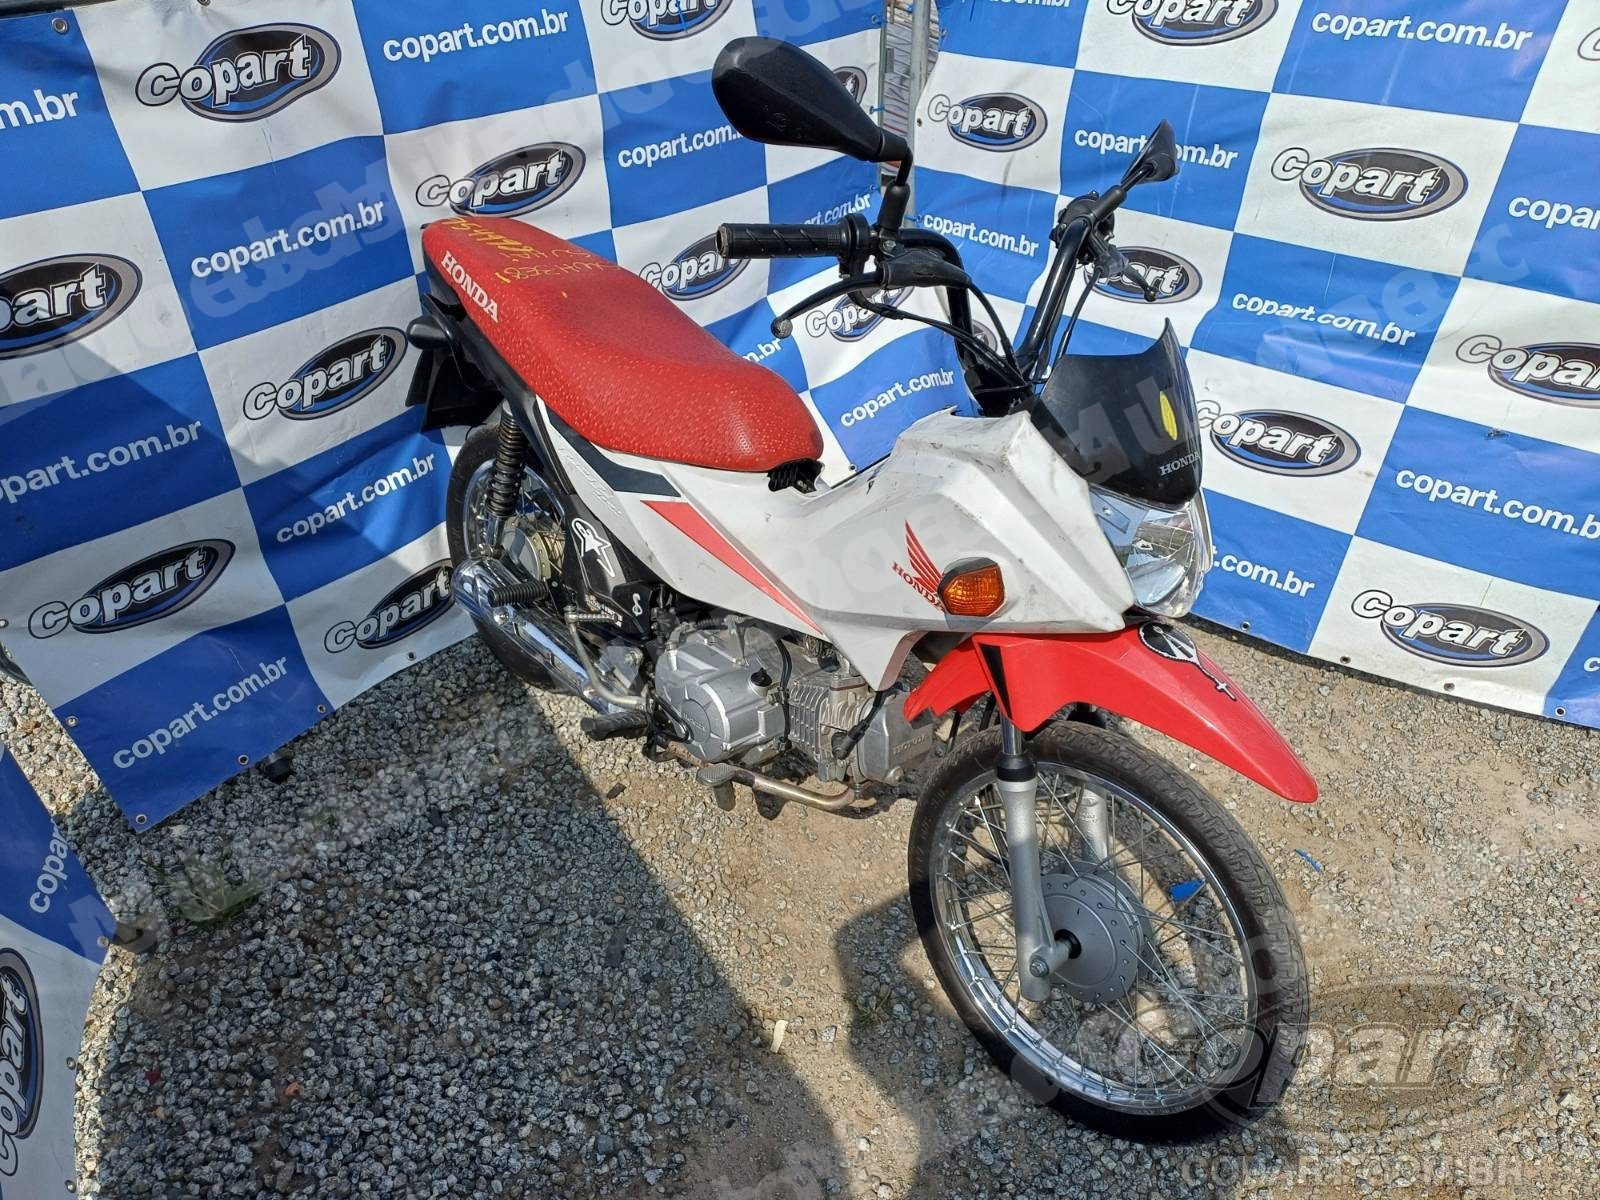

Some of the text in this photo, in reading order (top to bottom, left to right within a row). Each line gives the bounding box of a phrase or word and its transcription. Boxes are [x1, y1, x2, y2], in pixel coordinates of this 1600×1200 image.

[383, 9, 568, 62] copart.com.br
[1312, 12, 1533, 50] copart.com.br
[135, 34, 311, 108] Copart
[618, 125, 744, 168] copart.com.
[927, 94, 1033, 139] Copart
[416, 149, 565, 208] Copart
[1271, 147, 1446, 204] Copart
[190, 200, 384, 278] copart.com.br
[923, 212, 1040, 258] copart.com.br
[441, 250, 499, 323] HONDA
[1233, 293, 1416, 346] copart.com.br
[243, 334, 390, 420] Copart
[841, 367, 954, 427] copart.com.br
[0, 421, 201, 504] part.com.br
[1159, 451, 1201, 476] HONDA
[1196, 399, 1339, 465] Copart
[276, 453, 435, 543] copart.com.br
[28, 546, 210, 640] Copart
[324, 568, 452, 654] Copart
[1351, 590, 1526, 656] Copart
[113, 655, 289, 769] copart.com.br
